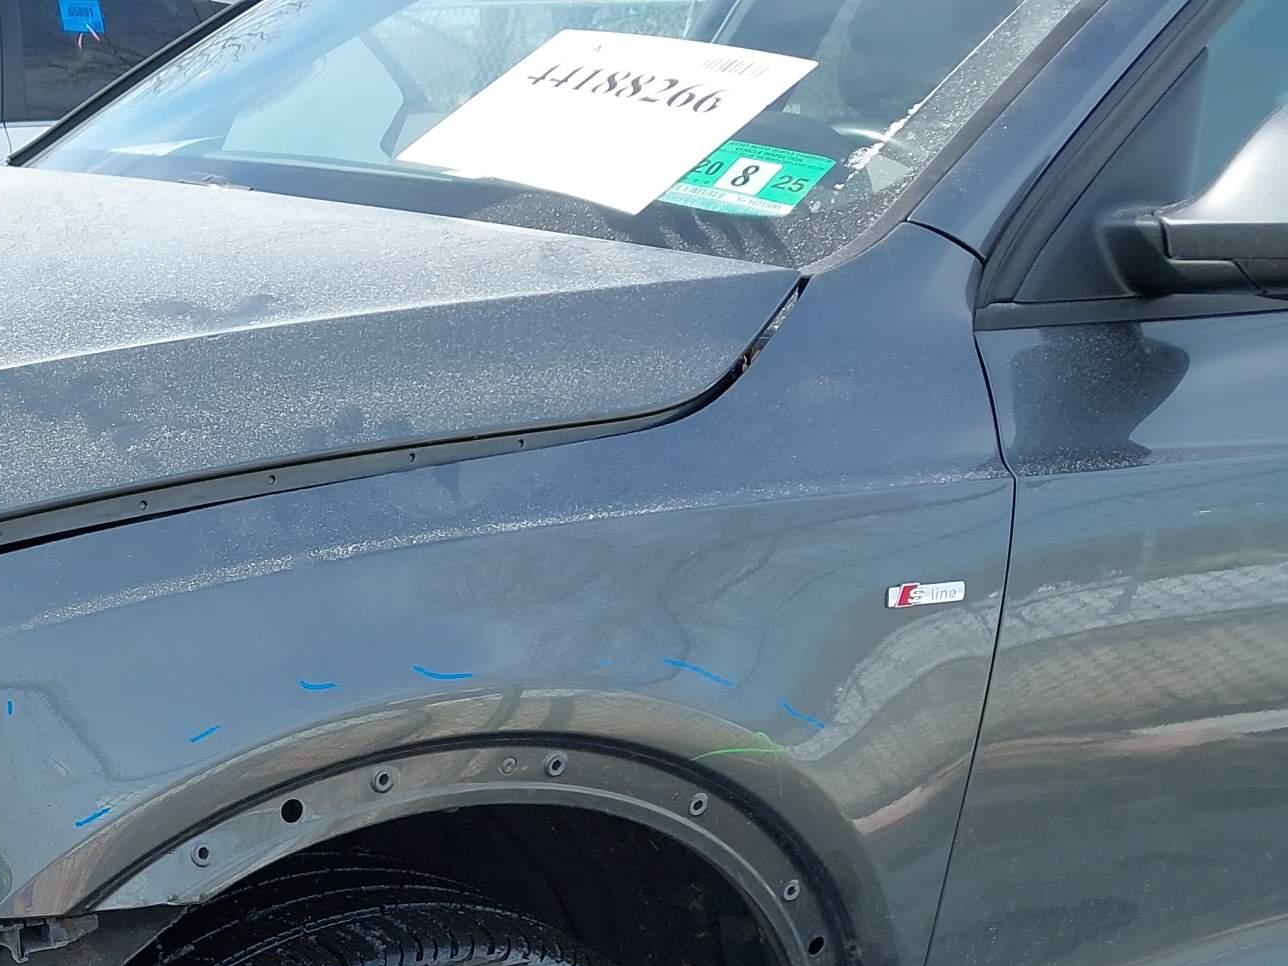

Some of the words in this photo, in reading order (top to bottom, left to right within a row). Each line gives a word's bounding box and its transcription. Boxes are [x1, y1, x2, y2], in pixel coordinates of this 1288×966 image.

[527, 64, 728, 113] 44188266
[730, 164, 761, 187] 8
[772, 175, 809, 194] 25
[930, 586, 957, 601] line
